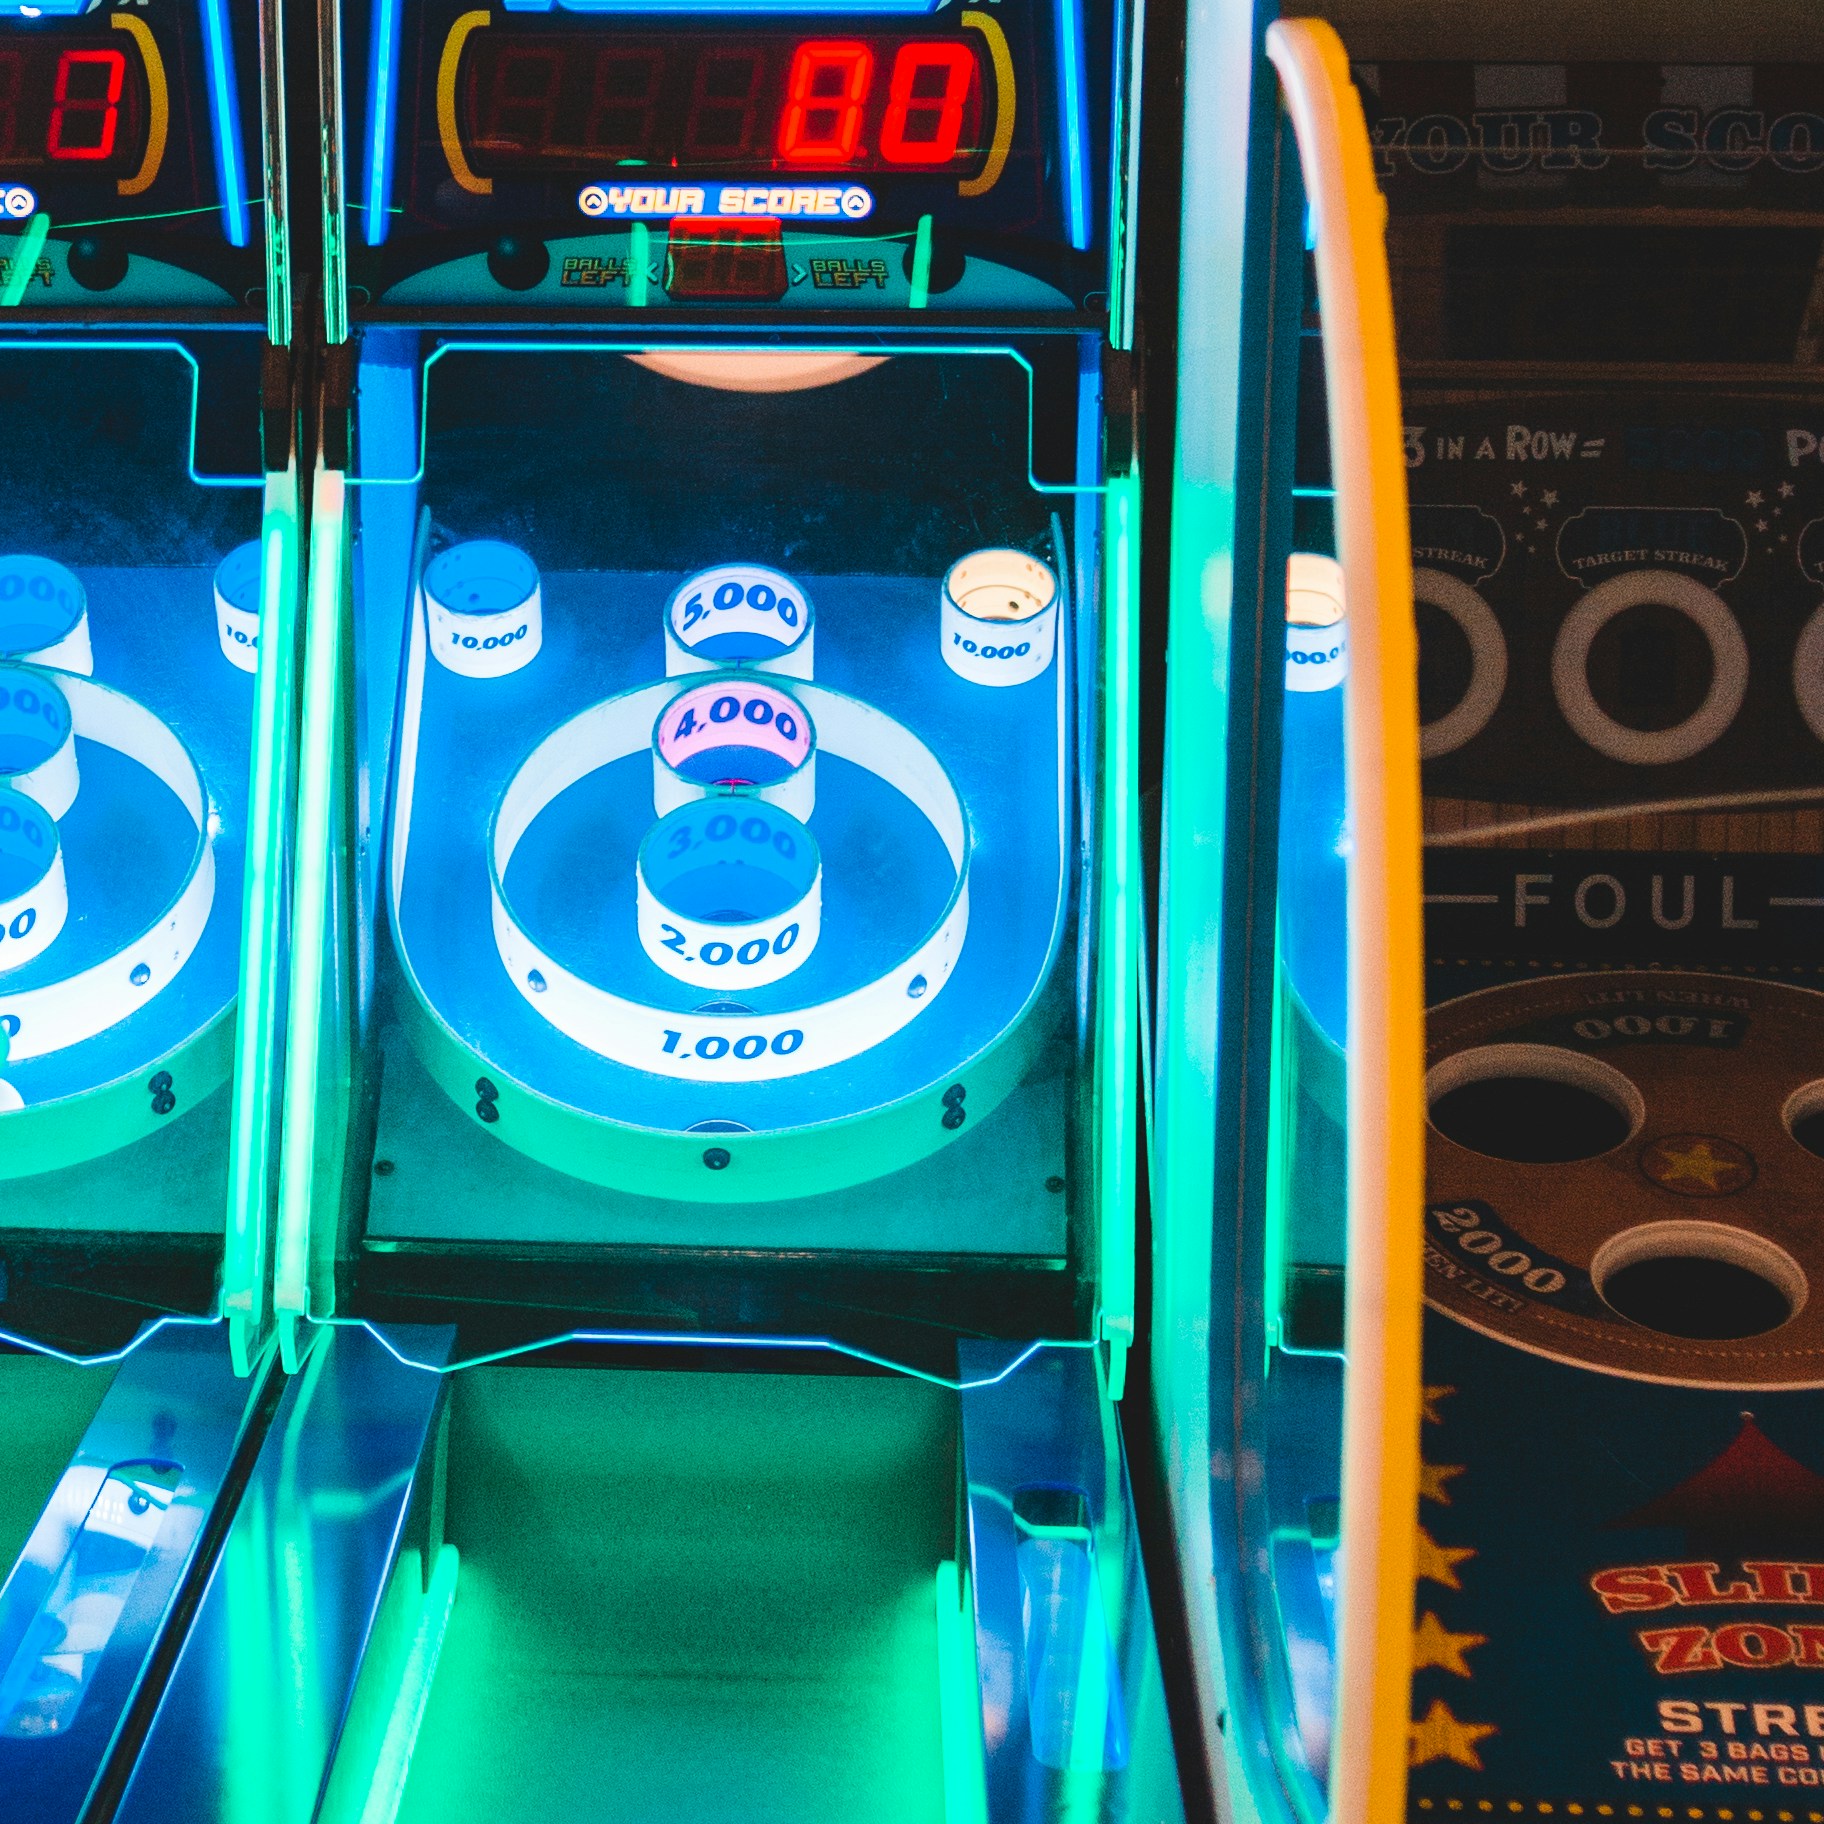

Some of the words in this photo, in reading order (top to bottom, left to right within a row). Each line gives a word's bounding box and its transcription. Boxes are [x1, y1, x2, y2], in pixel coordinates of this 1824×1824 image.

[609, 188, 705, 214] YOUR
[717, 188, 841, 214] SCORE
[811, 259, 885, 272] BALLS
[814, 271, 888, 286] LEFT
[1404, 426, 1426, 467] 3
[1437, 436, 1465, 461] IN
[1475, 436, 1496, 460] A
[1785, 429, 1824, 467] P
[1573, 549, 1648, 570] TARGET
[1654, 549, 1728, 573] STREAK
[682, 581, 798, 631] 5,000
[449, 624, 529, 651] 10,000
[953, 632, 1031, 661] 10,000
[672, 696, 798, 743] 4,000
[666, 813, 797, 861] 3,000
[1513, 874, 1759, 931] FOUL
[660, 922, 801, 966] 2,000
[661, 1029, 804, 1060] 1,000
[1432, 1207, 1567, 1294] 2000
[1591, 1560, 1824, 1614] SLI
[1625, 1738, 1682, 1758] GET
[1698, 1741, 1718, 1759] 3
[1727, 1741, 1810, 1761] BAGS
[1611, 1761, 1672, 1782] THE
[1680, 1763, 1769, 1786] SAME
[1778, 1766, 1824, 1787] CO
